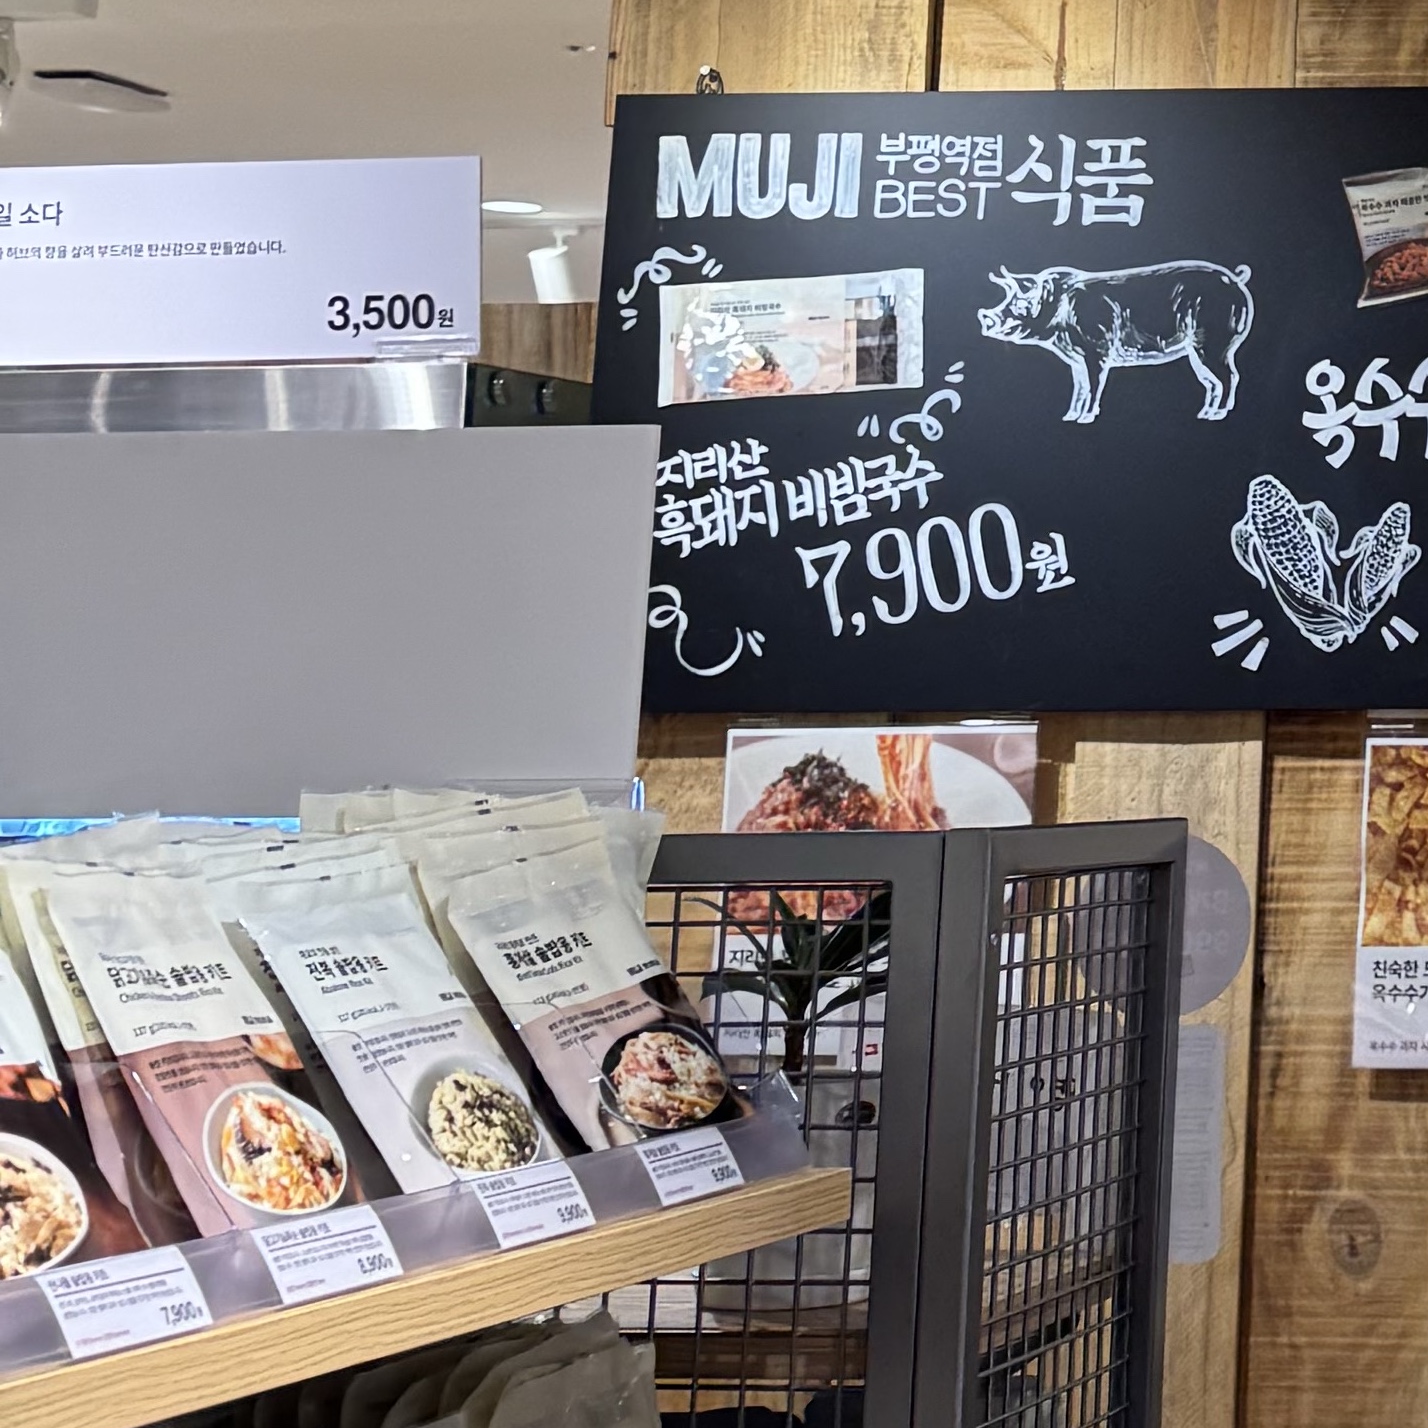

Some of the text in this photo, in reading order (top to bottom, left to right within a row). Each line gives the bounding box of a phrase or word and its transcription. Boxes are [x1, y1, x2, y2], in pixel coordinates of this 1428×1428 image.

[656, 132, 1155, 226] MUJI 부평역점 BEST 식품
[18, 201, 64, 227] 소다
[326, 293, 456, 338] 3,500원
[654, 439, 770, 489] 지리산
[652, 444, 945, 559] 흑돼지 비빔국수
[1372, 959, 1419, 979] 친숙한
